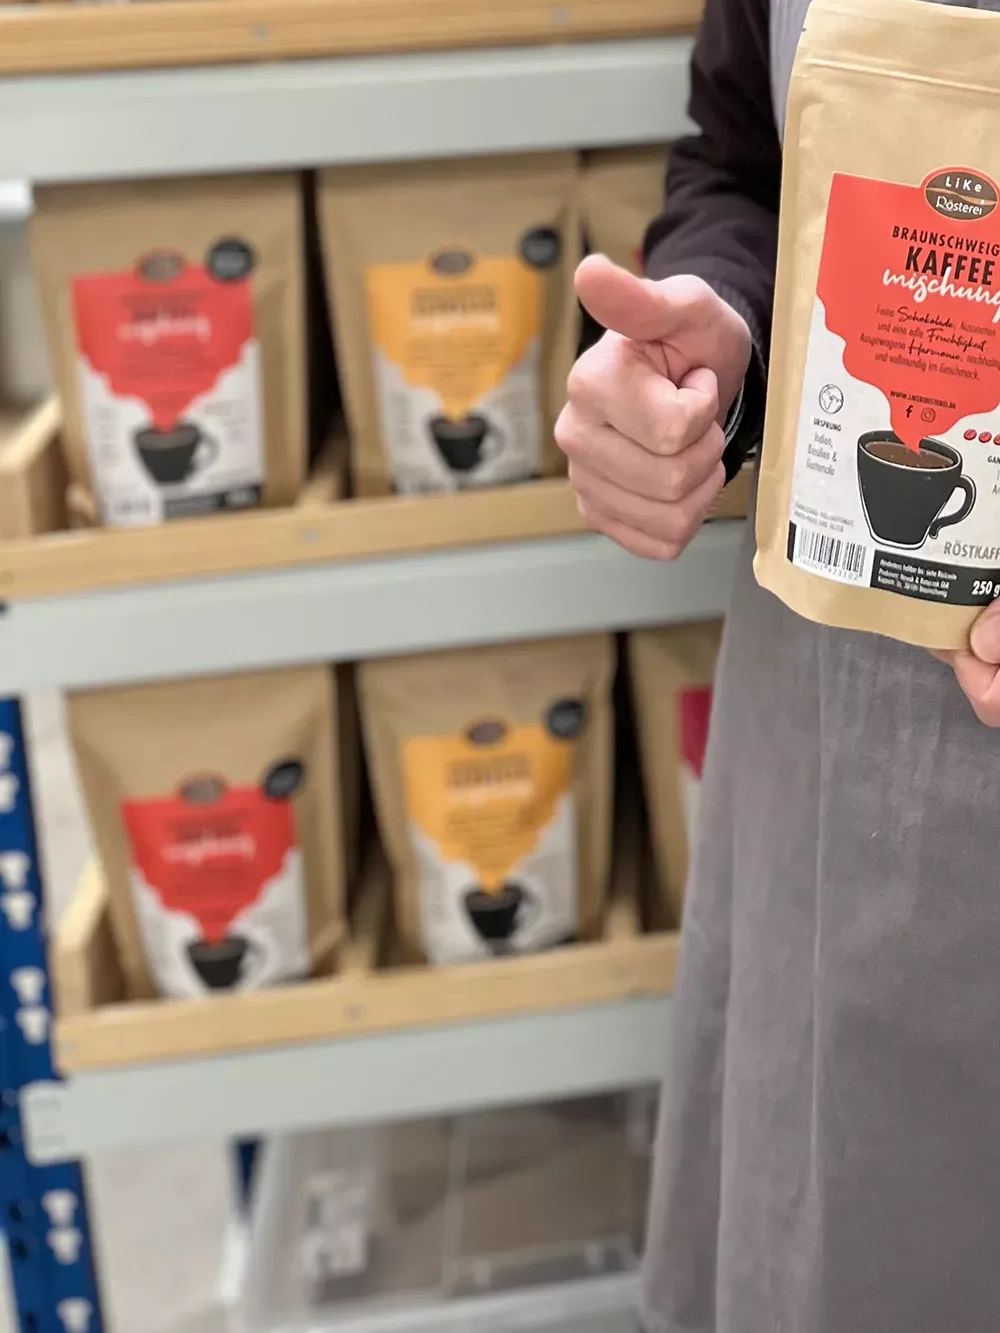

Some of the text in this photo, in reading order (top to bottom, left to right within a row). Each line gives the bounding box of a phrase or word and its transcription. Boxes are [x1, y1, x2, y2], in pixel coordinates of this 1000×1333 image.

[945, 176, 983, 193] LiKe
[936, 195, 985, 216] Rösterei
[905, 246, 996, 286] KAFFEE
[971, 580, 1000, 597] 250 g
